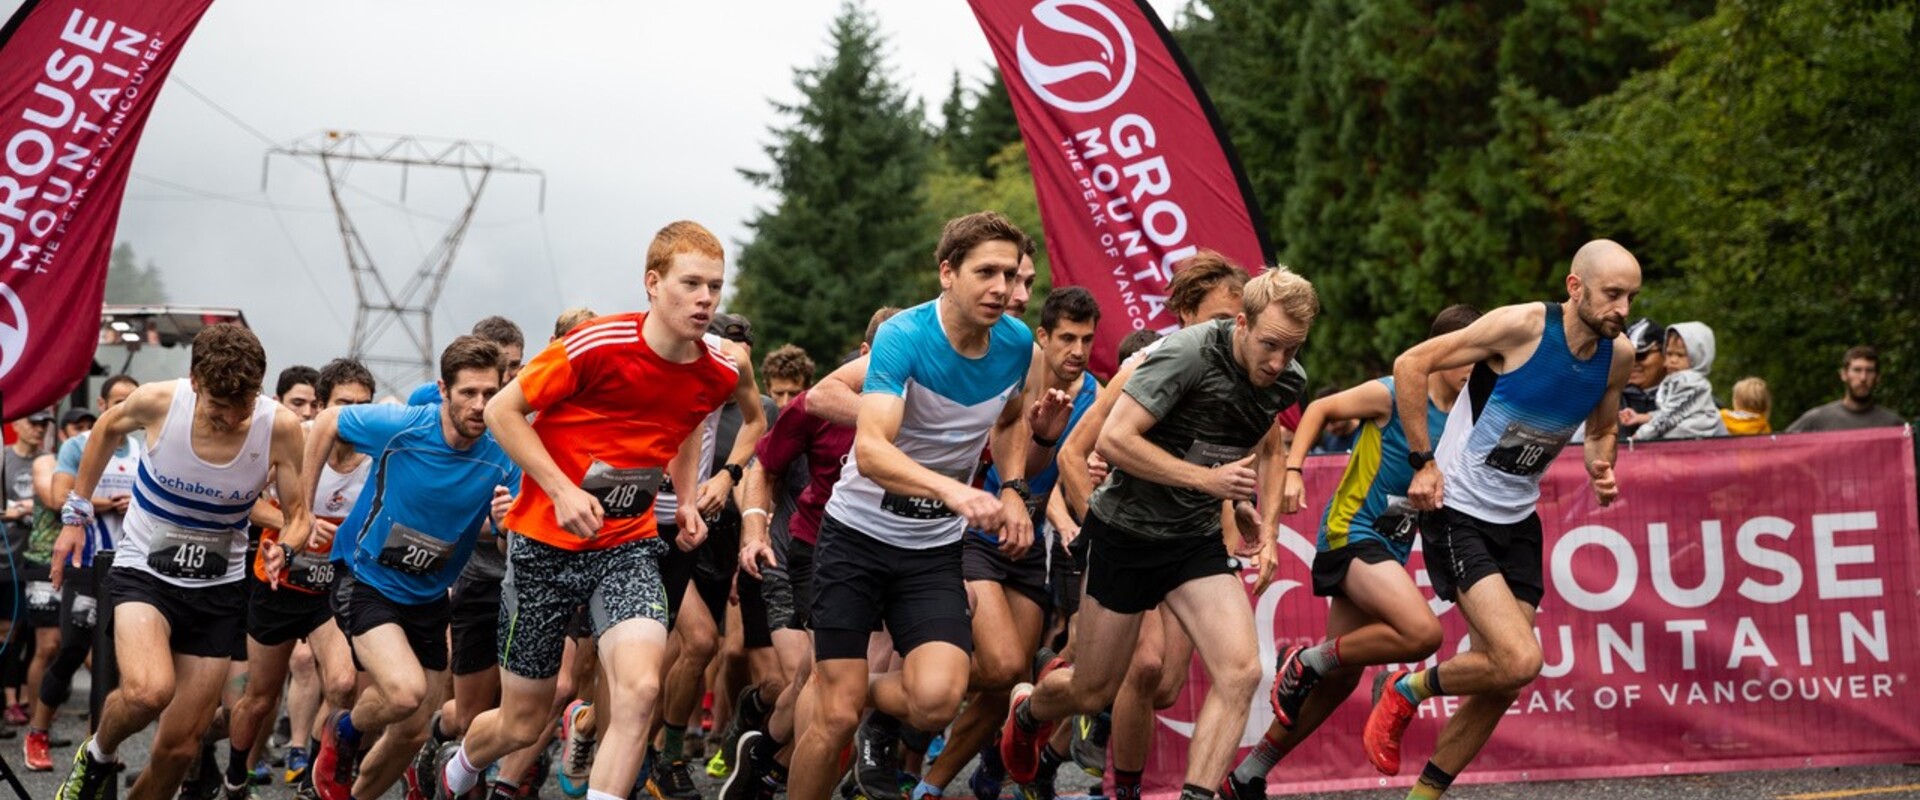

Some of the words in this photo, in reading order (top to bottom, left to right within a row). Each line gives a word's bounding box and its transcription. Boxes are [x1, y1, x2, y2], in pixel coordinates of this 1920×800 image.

[11, 26, 147, 271] MOUNTAIN
[35, 241, 60, 274] THE
[57, 187, 88, 234] PEAK
[86, 157, 102, 180] OF
[99, 35, 165, 150] VANCOUVER
[1076, 127, 1181, 336] MOUNTAI
[1109, 113, 1198, 283] GROU
[1061, 138, 1083, 173] THE
[1079, 177, 1106, 227] PEAK
[1101, 233, 1119, 258] OF
[1113, 264, 1145, 330] VANCO
[1515, 443, 1545, 467] 118
[604, 484, 639, 508] 418
[172, 543, 207, 569] 413
[306, 564, 336, 583] 366
[401, 545, 439, 569] 207
[1410, 511, 1884, 616] OUSE
[1386, 610, 1890, 678] UNTAIN
[1593, 686, 1641, 711] OF
[1658, 674, 1895, 705] VANCOUVER
